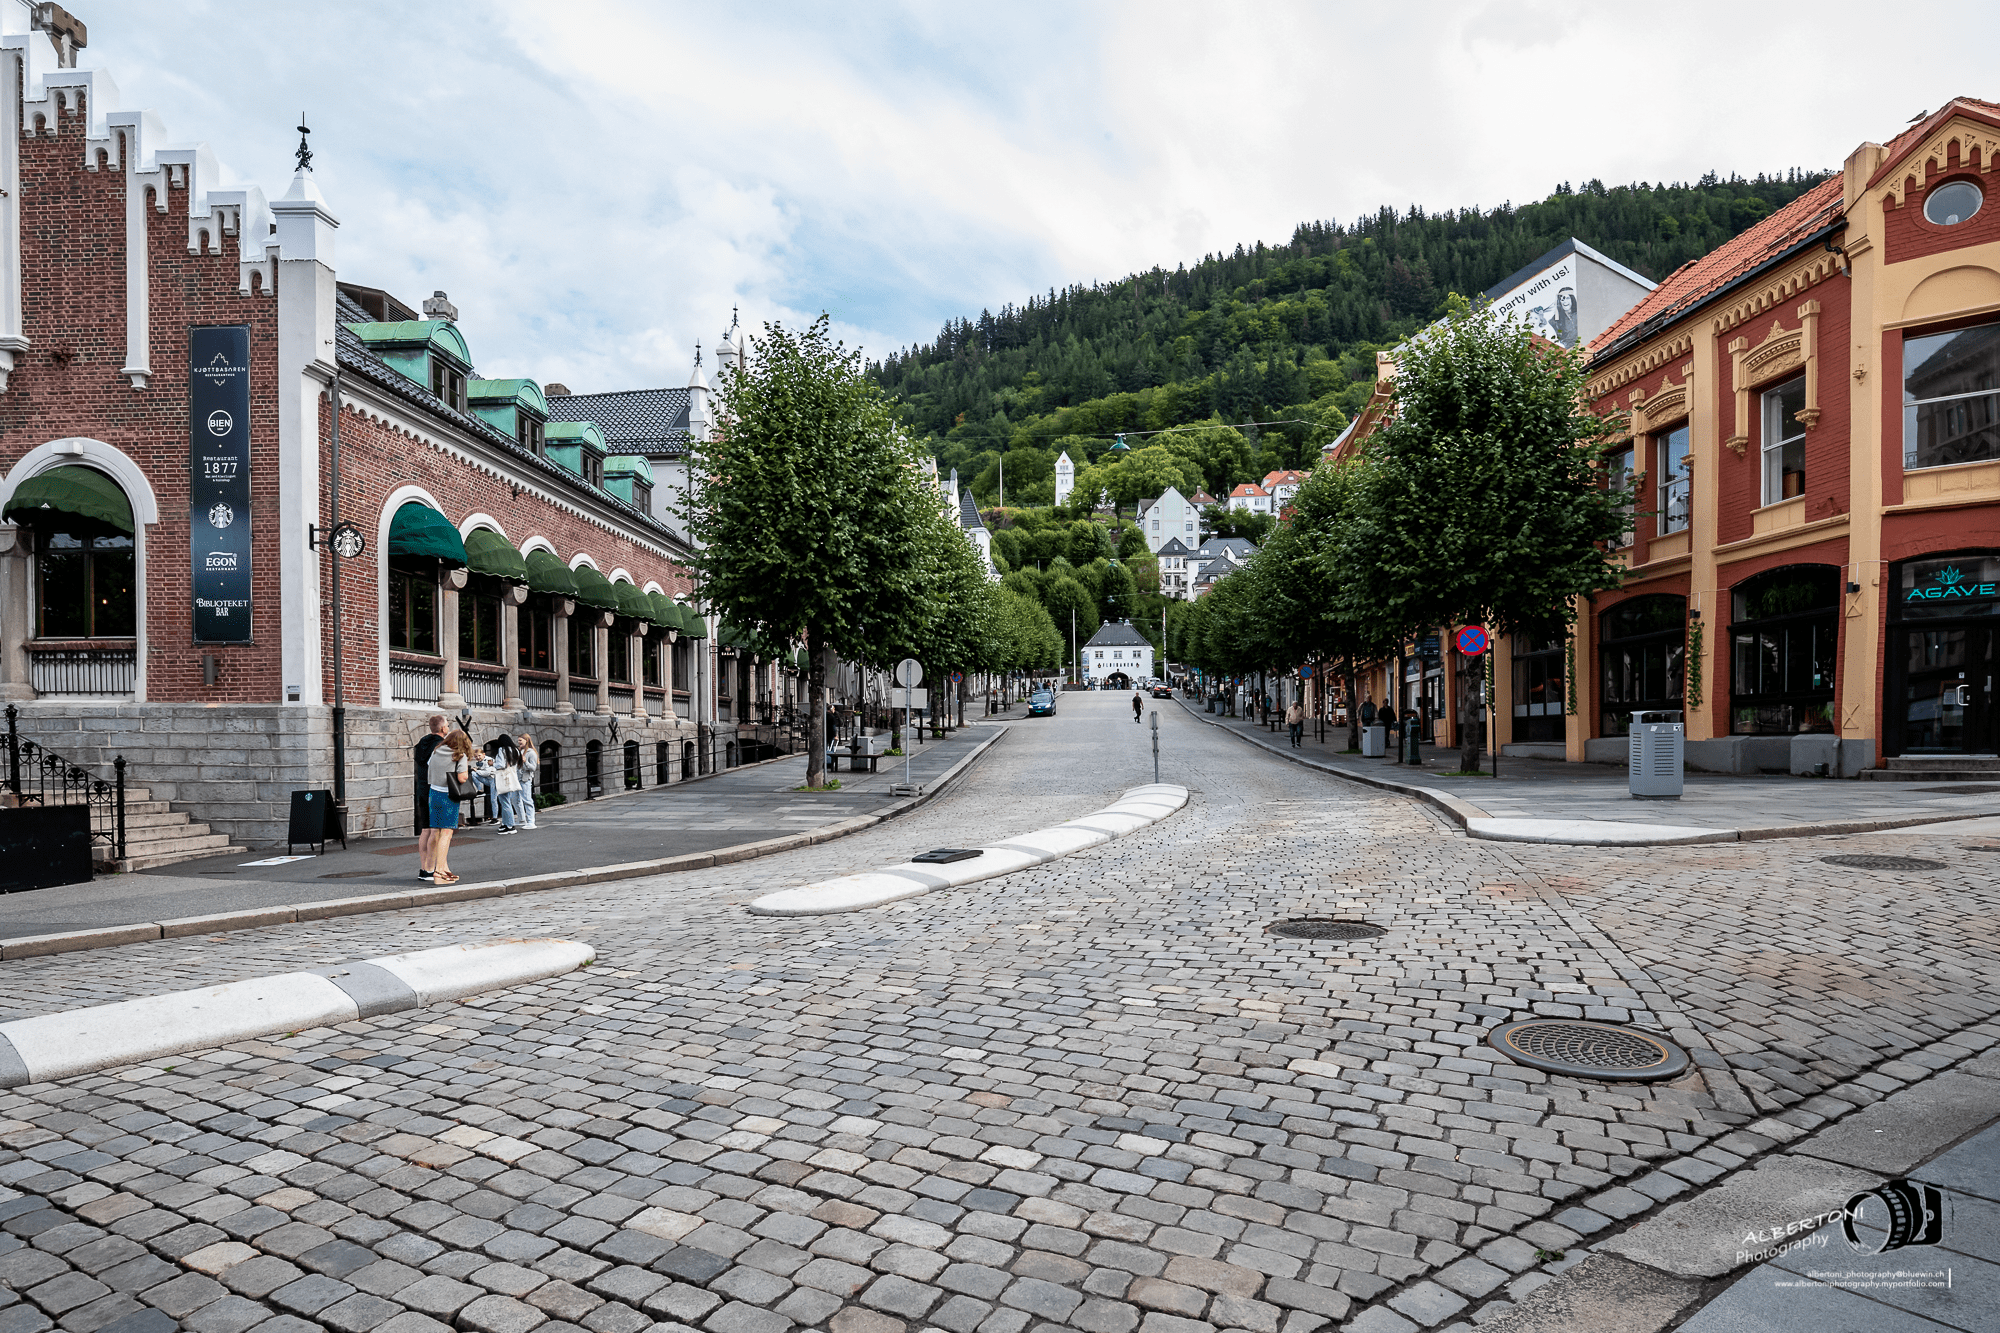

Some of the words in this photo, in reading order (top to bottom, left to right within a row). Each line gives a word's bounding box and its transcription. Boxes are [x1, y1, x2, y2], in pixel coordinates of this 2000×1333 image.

[1499, 293, 1526, 316] party
[1527, 278, 1551, 296] with
[1551, 265, 1570, 281] us!
[209, 419, 231, 427] BIEN
[204, 462, 238, 474] 1877
[205, 557, 237, 567] EGON
[1906, 583, 1996, 600] AGAVE
[215, 607, 229, 617] BAR
